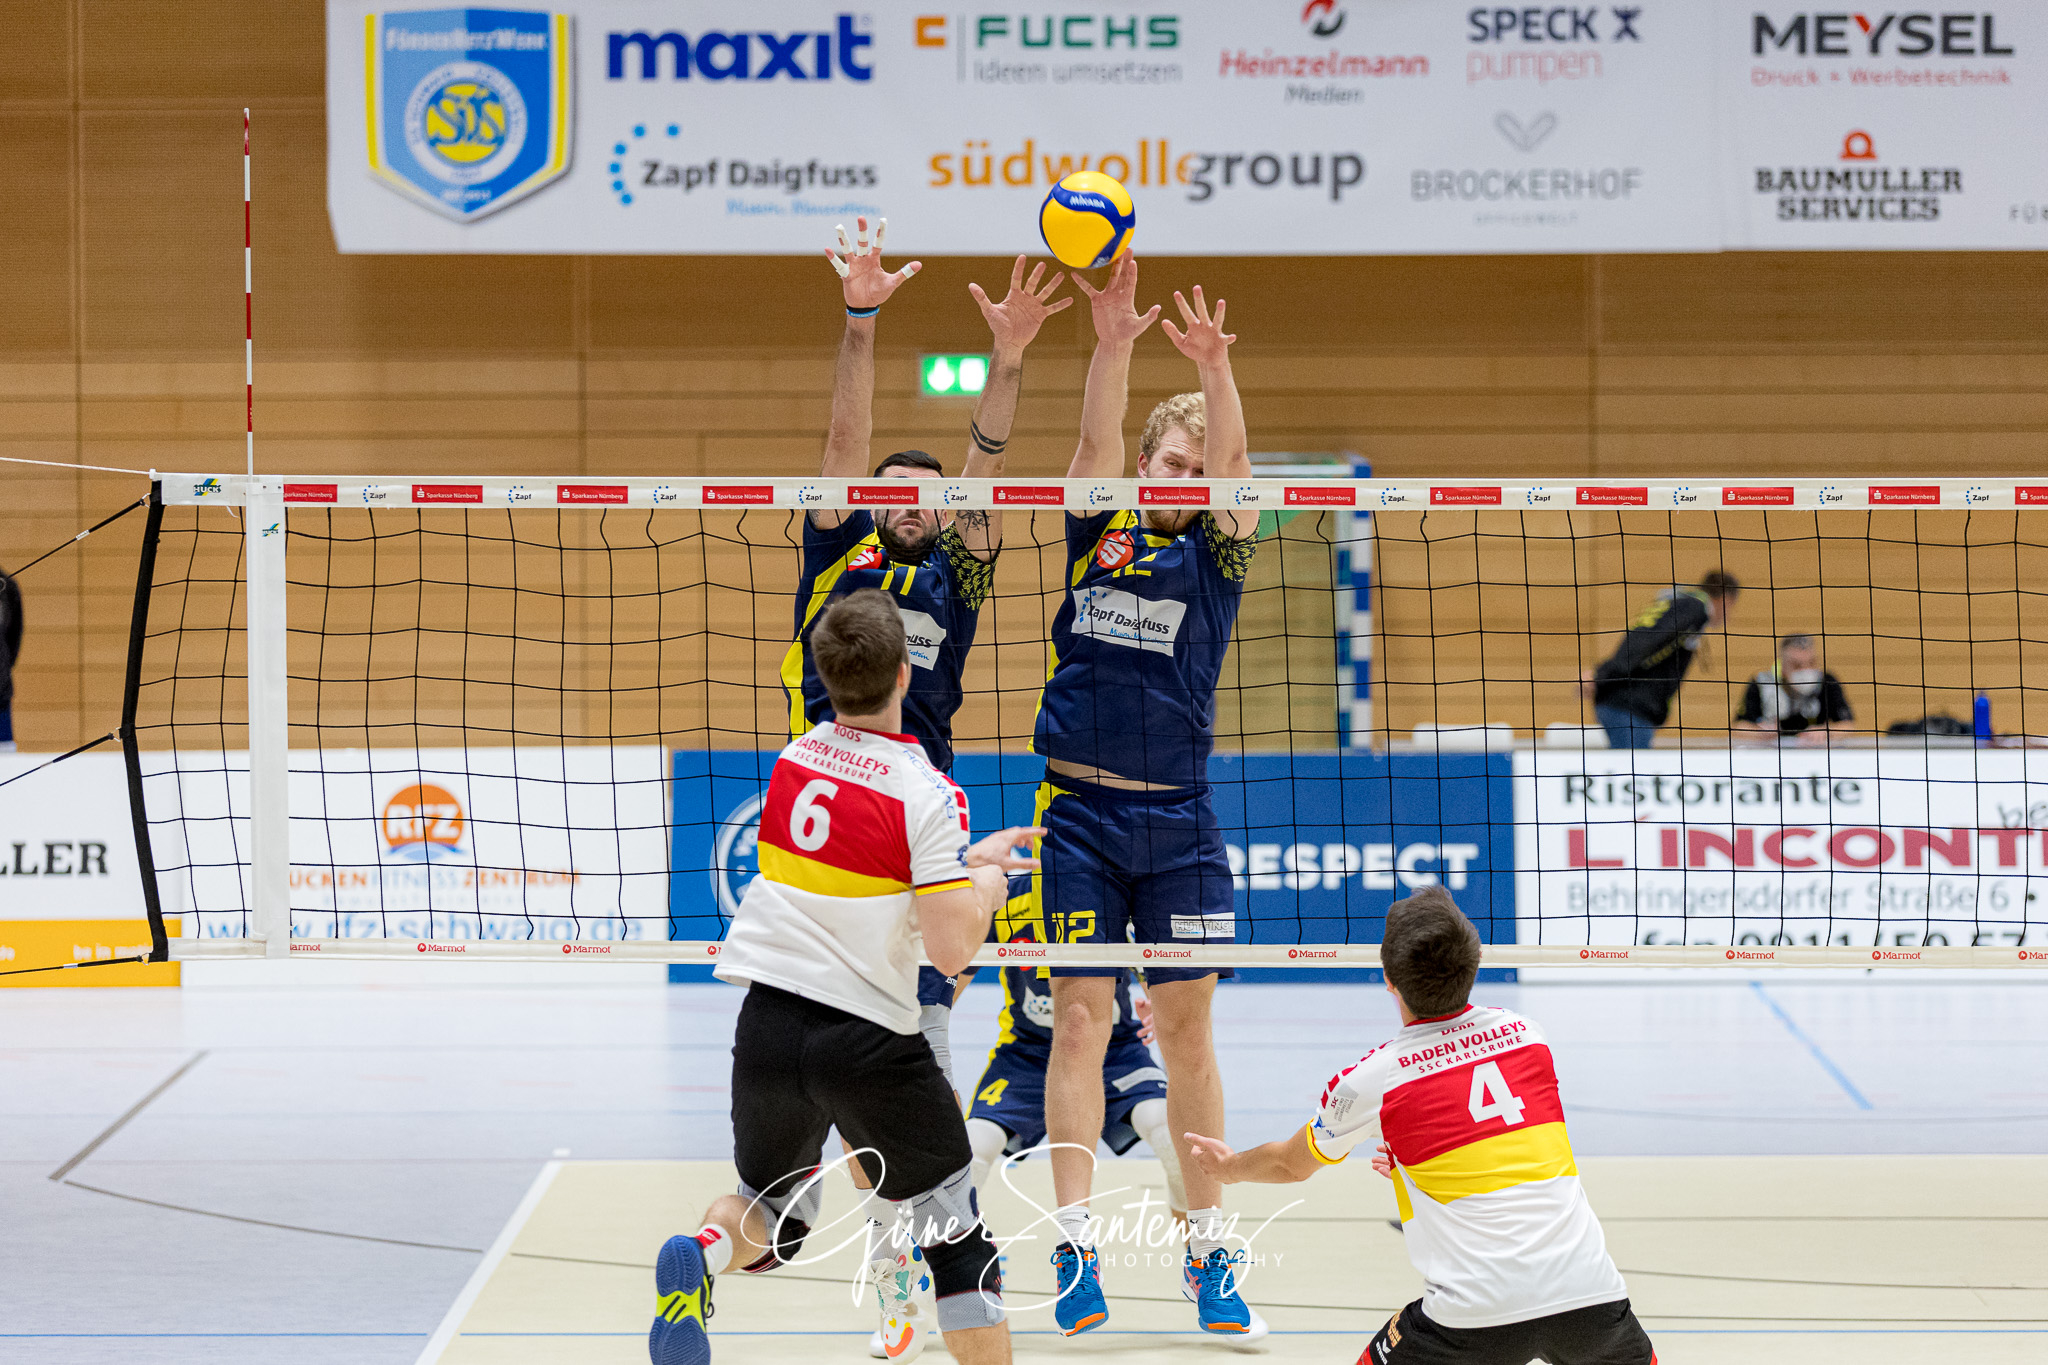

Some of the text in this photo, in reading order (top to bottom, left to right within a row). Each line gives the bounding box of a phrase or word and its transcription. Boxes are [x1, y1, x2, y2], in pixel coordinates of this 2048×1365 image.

[1468, 8, 1599, 42] SPECK
[977, 16, 1179, 48] FUCHS
[1752, 14, 2015, 56] MEYSEL
[607, 16, 873, 81] maxit
[1219, 50, 1430, 77] Heinzelmann
[1466, 49, 1602, 84] pumpen
[974, 61, 1047, 84] Ideen
[643, 159, 877, 193] Zapf Daigfuss
[1777, 197, 1940, 221] SERVICES
[283, 492, 332, 500] parkasse Nürnberg
[370, 492, 386, 500] Zapf
[426, 492, 478, 501] Sparkasse Nürnberg
[516, 493, 532, 501] Zapf
[572, 492, 624, 501] Sparkasse Nürnberg
[660, 494, 677, 502] Zapf
[716, 494, 768, 502] Sparkasse Nürnberg
[806, 494, 822, 502] Zapf
[862, 494, 914, 502] Sparkasse Nürnberg
[952, 494, 968, 502] Zapf
[1008, 494, 1060, 503] Sparkasse Nürnberg
[1096, 494, 1113, 502] Zapf
[1154, 494, 1206, 503] Sparkasse Nürnberg
[1242, 495, 1259, 503] Zapf
[1300, 494, 1350, 503] Sparkasse Nürnberg
[1388, 495, 1405, 503] Zapf
[1444, 494, 1496, 503] Sparkasse Nürnberg
[1534, 495, 1551, 503] Zapf
[1590, 494, 1642, 503] Sparkasse Nürnberg
[1680, 495, 1697, 503] Zapf
[1738, 494, 1788, 503] Sparkasse Nürnberg
[1826, 494, 1843, 502] Zapf
[1884, 494, 1936, 502] Sparkasse Nürnberg
[1972, 494, 1989, 502] Zapf
[833, 725, 862, 742] ROOS
[796, 736, 891, 776] BADEN VOLLEYS
[794, 750, 874, 782] SSC KARLSRUHE
[1565, 772, 1861, 804] Ristorante
[790, 779, 839, 851] 6
[386, 803, 462, 839] RFZ
[0, 842, 109, 876] LER
[1227, 842, 1479, 891] RESPECT
[1567, 879, 2010, 914] Behringersdorfer Straße 6
[1052, 910, 1096, 943] 12
[290, 944, 321, 953] armot
[428, 945, 465, 953] Marmot
[573, 946, 610, 954] Marmot
[1009, 949, 1046, 957] Marmot
[1154, 950, 1191, 958] Marmot
[1591, 950, 1628, 958] Marmot
[1737, 952, 1774, 960] Marmot
[1883, 952, 1920, 960] Marmot
[1398, 1020, 1526, 1068] BADEN VOLLEYS
[1419, 1036, 1522, 1074] SSC KARLSRUHE
[977, 1079, 1009, 1106] 4
[1468, 1061, 1526, 1126] 4
